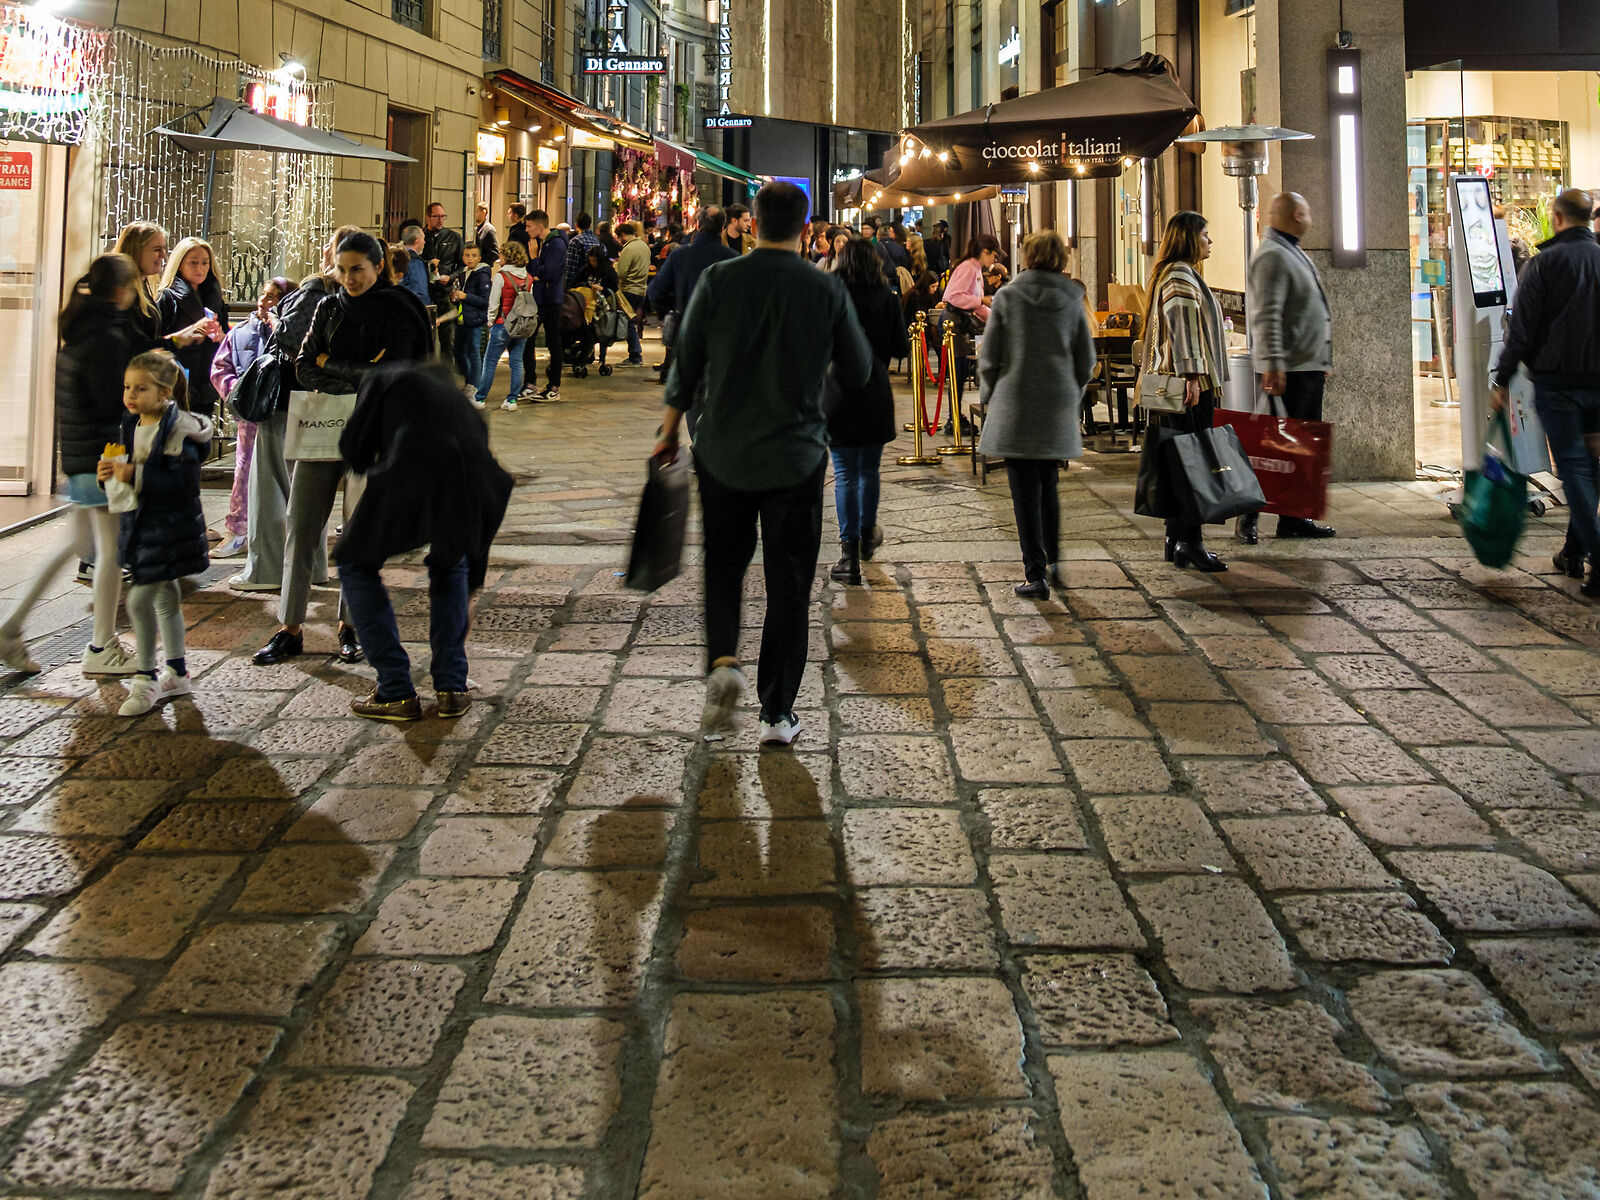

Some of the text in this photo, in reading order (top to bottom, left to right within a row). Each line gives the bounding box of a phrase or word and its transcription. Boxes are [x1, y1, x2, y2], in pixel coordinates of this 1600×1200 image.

[586, 58, 663, 71] Di Gennaro
[706, 117, 753, 128] Di Gennaro
[0, 164, 30, 174] RATA
[298, 419, 345, 428] MANGO
